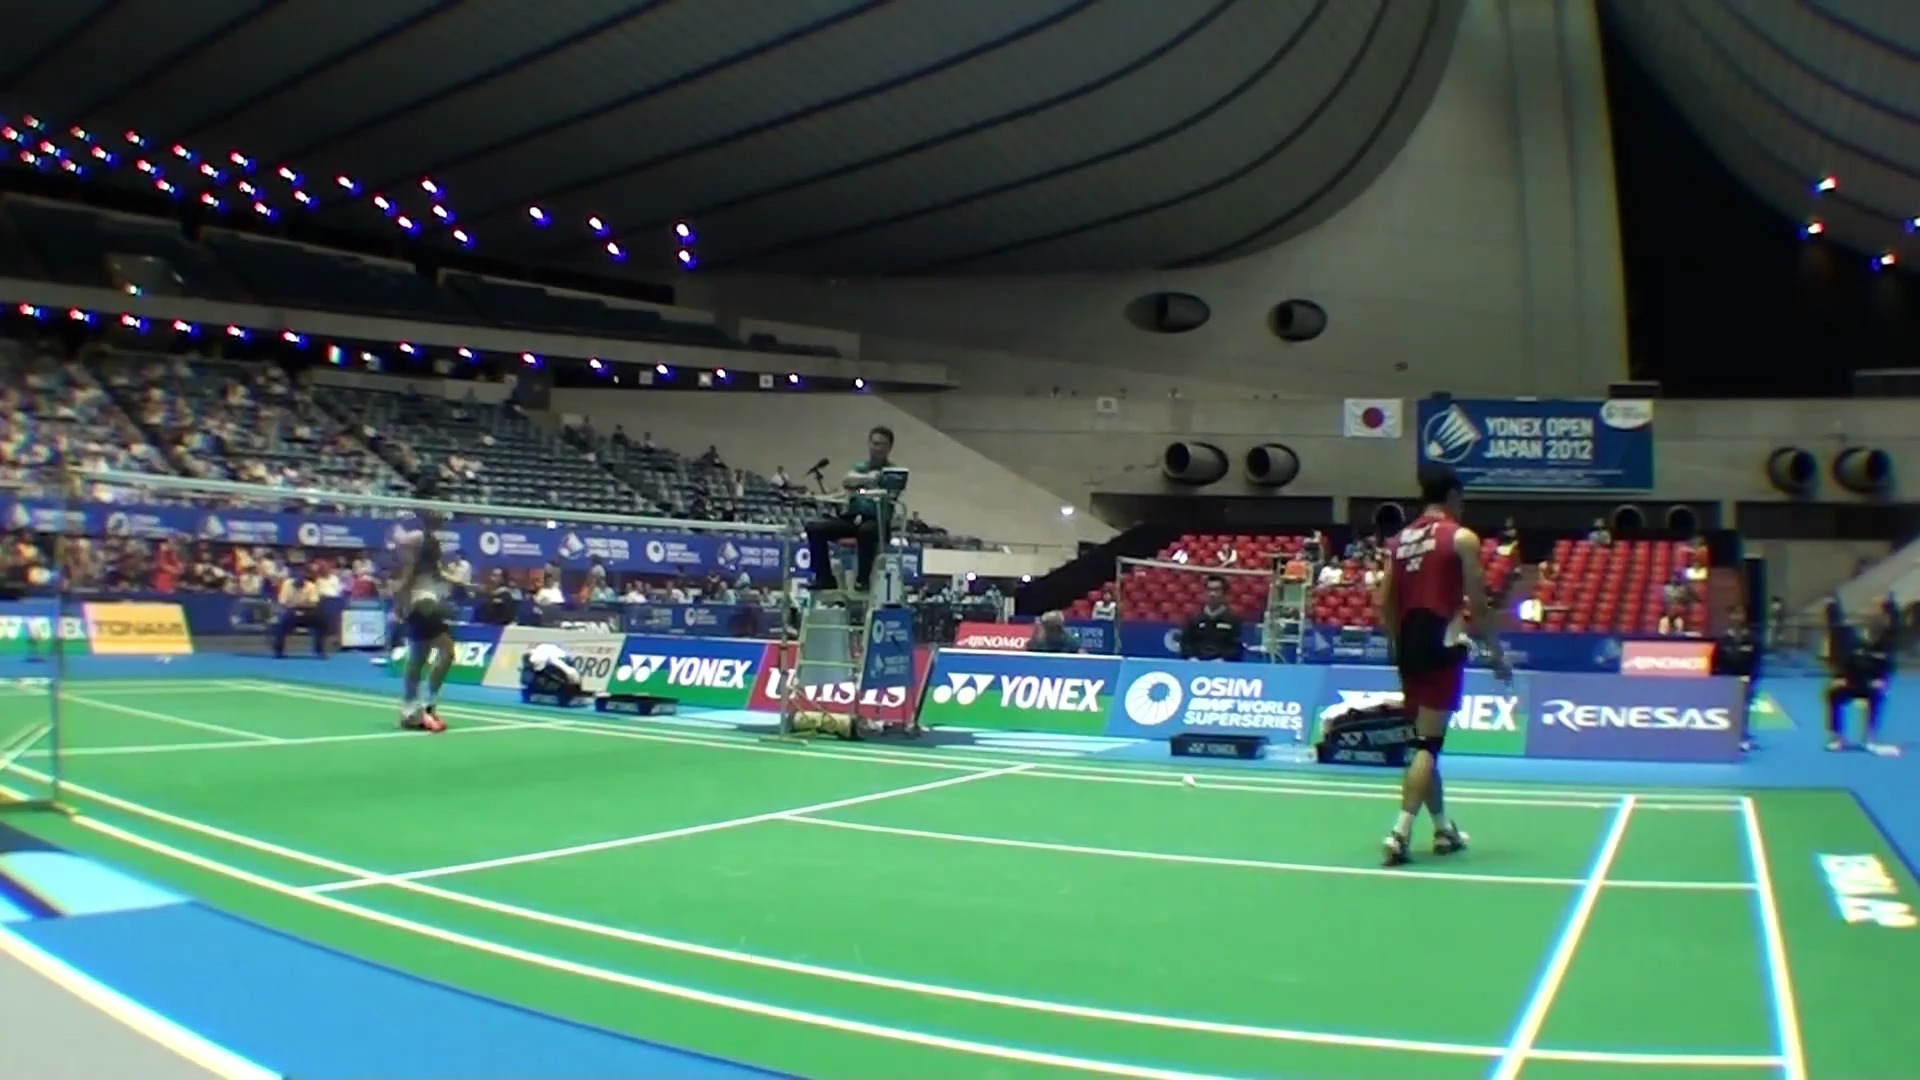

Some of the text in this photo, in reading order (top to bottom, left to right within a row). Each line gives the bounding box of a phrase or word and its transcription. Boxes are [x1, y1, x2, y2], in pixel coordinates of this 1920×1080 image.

[1485, 417, 1594, 437] YONEX OPEN
[1483, 439, 1593, 460] JAPAN 2012
[667, 656, 752, 689] YONEX
[1000, 674, 1105, 712] YONEX
[1190, 676, 1262, 698] OSIM
[1237, 700, 1301, 715] WORLD
[1451, 695, 1518, 731] NEX
[1542, 699, 1731, 733] RENESAS
[1183, 711, 1302, 729] SUPERSERIES
